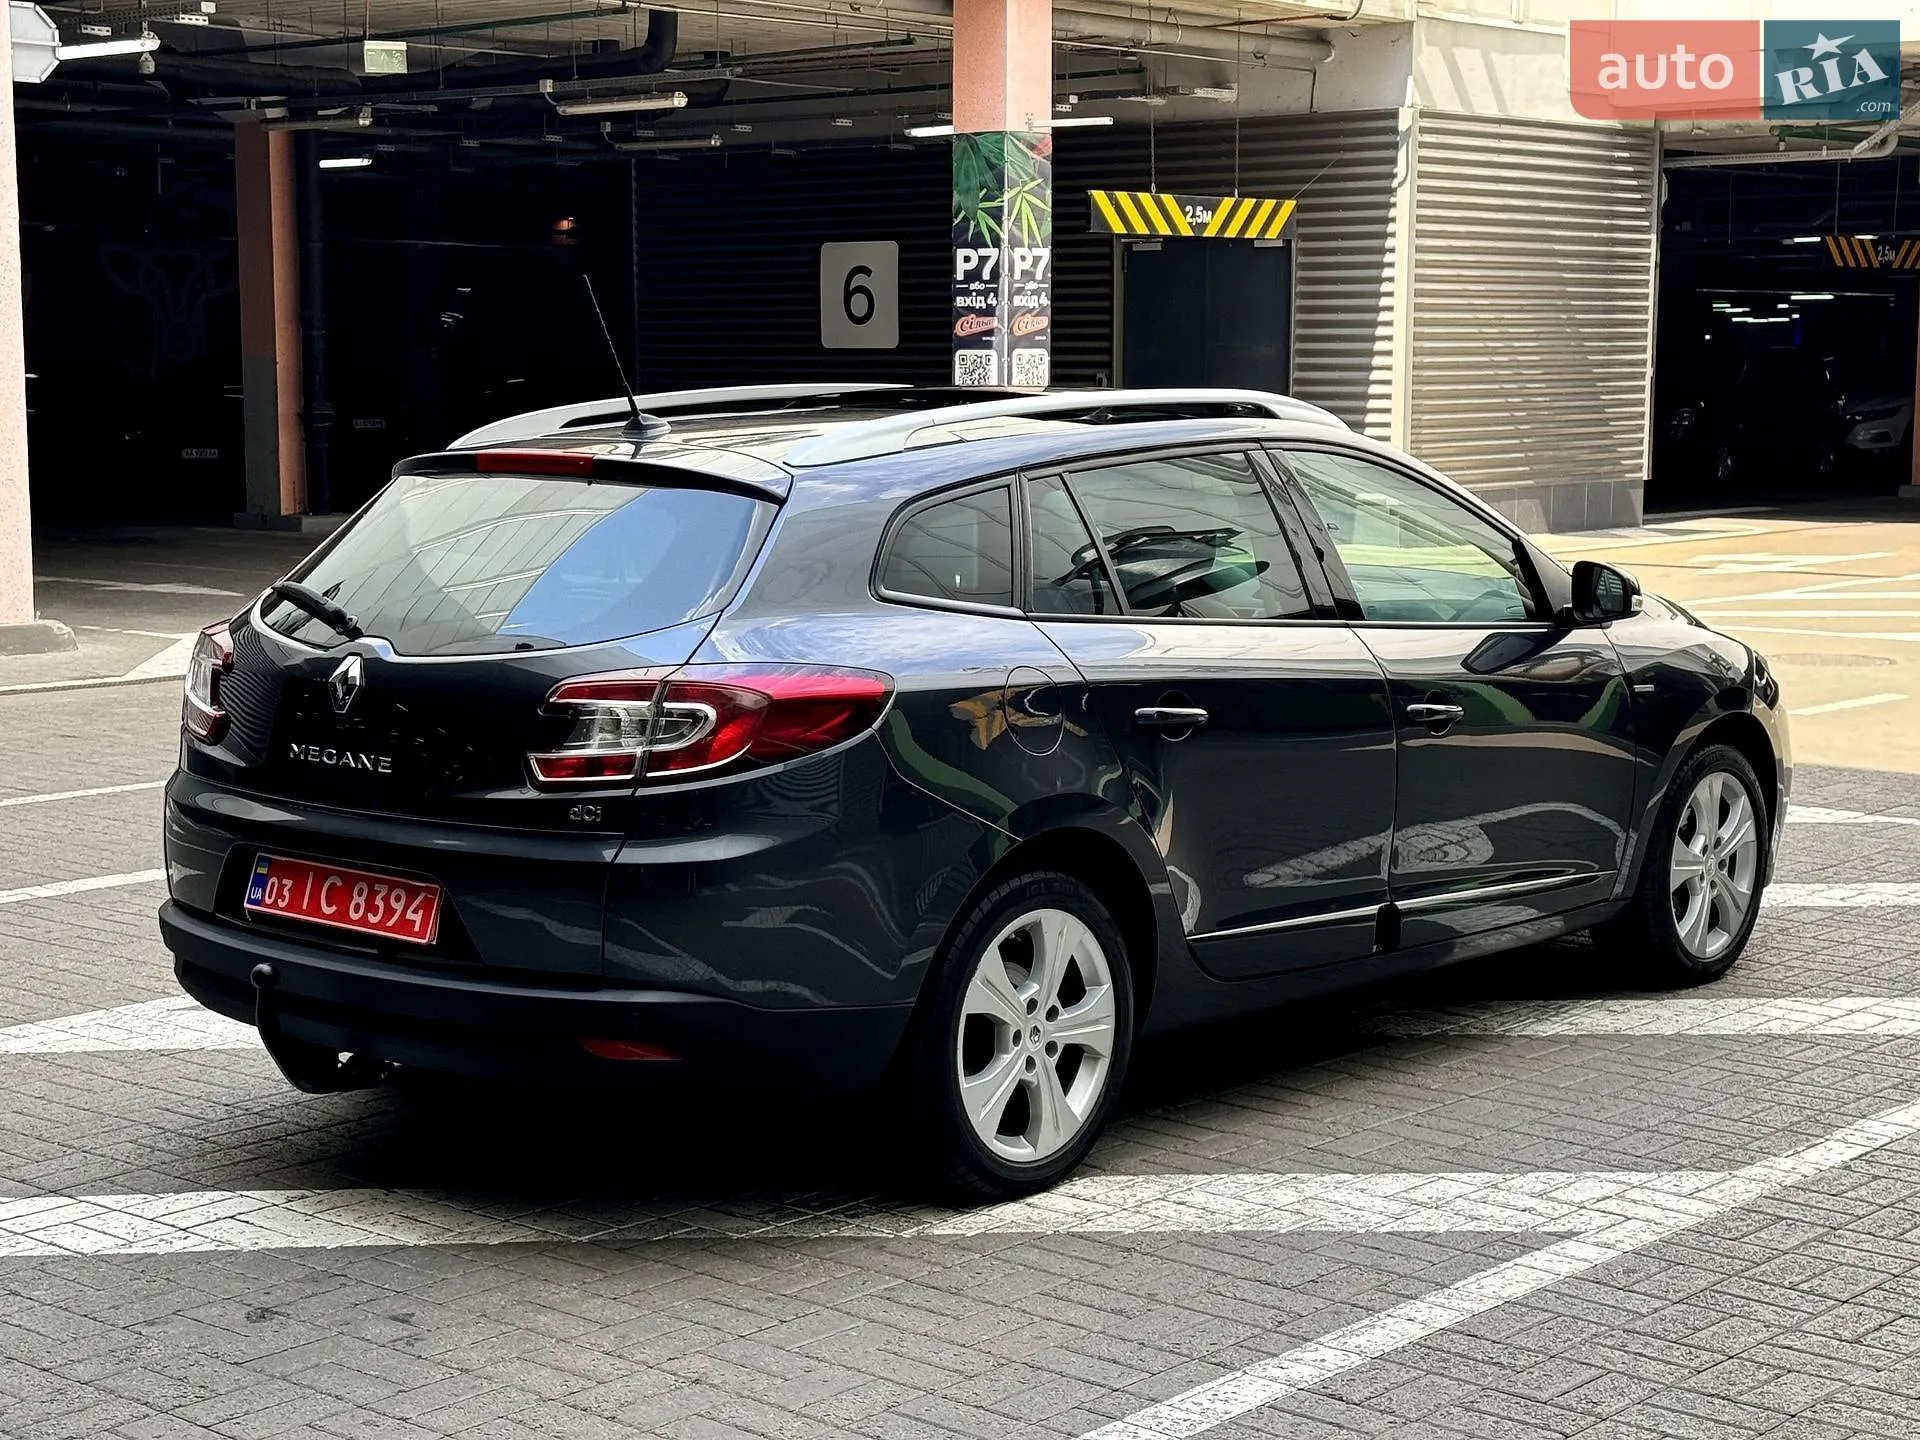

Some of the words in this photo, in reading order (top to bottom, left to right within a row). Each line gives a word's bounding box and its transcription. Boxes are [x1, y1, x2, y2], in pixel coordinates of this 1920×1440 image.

[956, 248, 999, 281] P7
[1013, 247, 1050, 281] P7
[843, 264, 875, 326] 6
[956, 291, 987, 309] вхід
[987, 292, 998, 307] 4
[1013, 290, 1039, 309] вхід
[1039, 291, 1048, 307] 4
[960, 317, 995, 333] Сільп
[1016, 317, 1048, 334] Сіл
[289, 743, 393, 773] MEGANE
[569, 804, 602, 822] dCi
[250, 886, 263, 901] UA
[264, 876, 293, 908] 03
[349, 881, 436, 932] 8394
